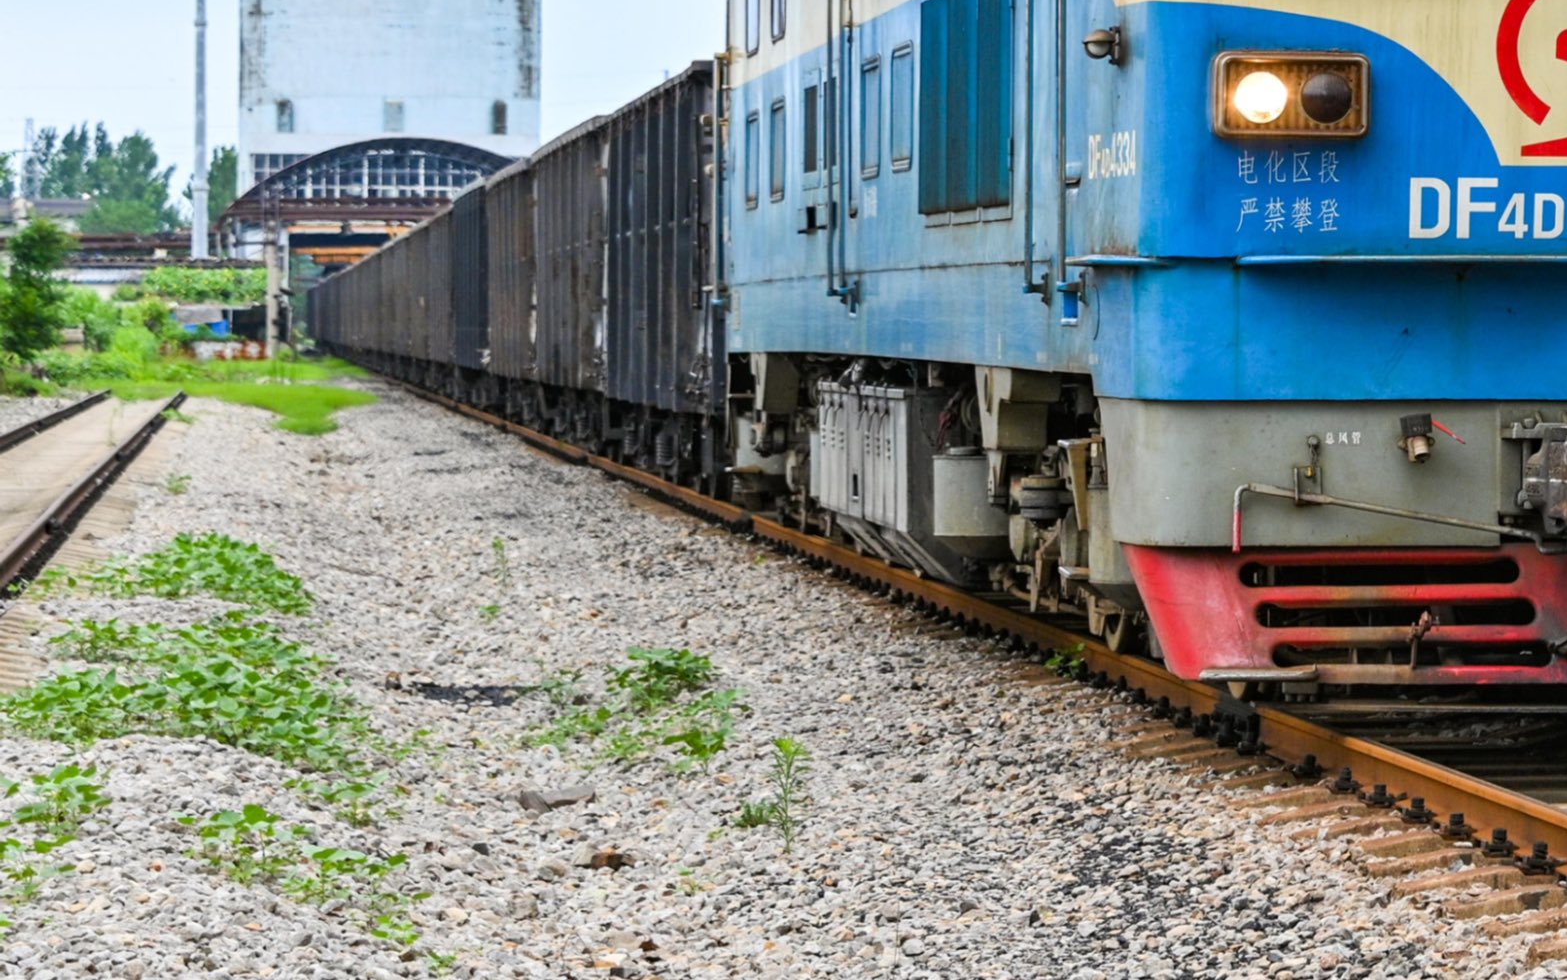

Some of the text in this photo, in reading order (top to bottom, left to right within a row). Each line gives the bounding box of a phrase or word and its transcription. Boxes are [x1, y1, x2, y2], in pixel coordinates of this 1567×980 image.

[1237, 150, 1340, 185] 电化区段
[1236, 197, 1340, 233] 严禁攀登
